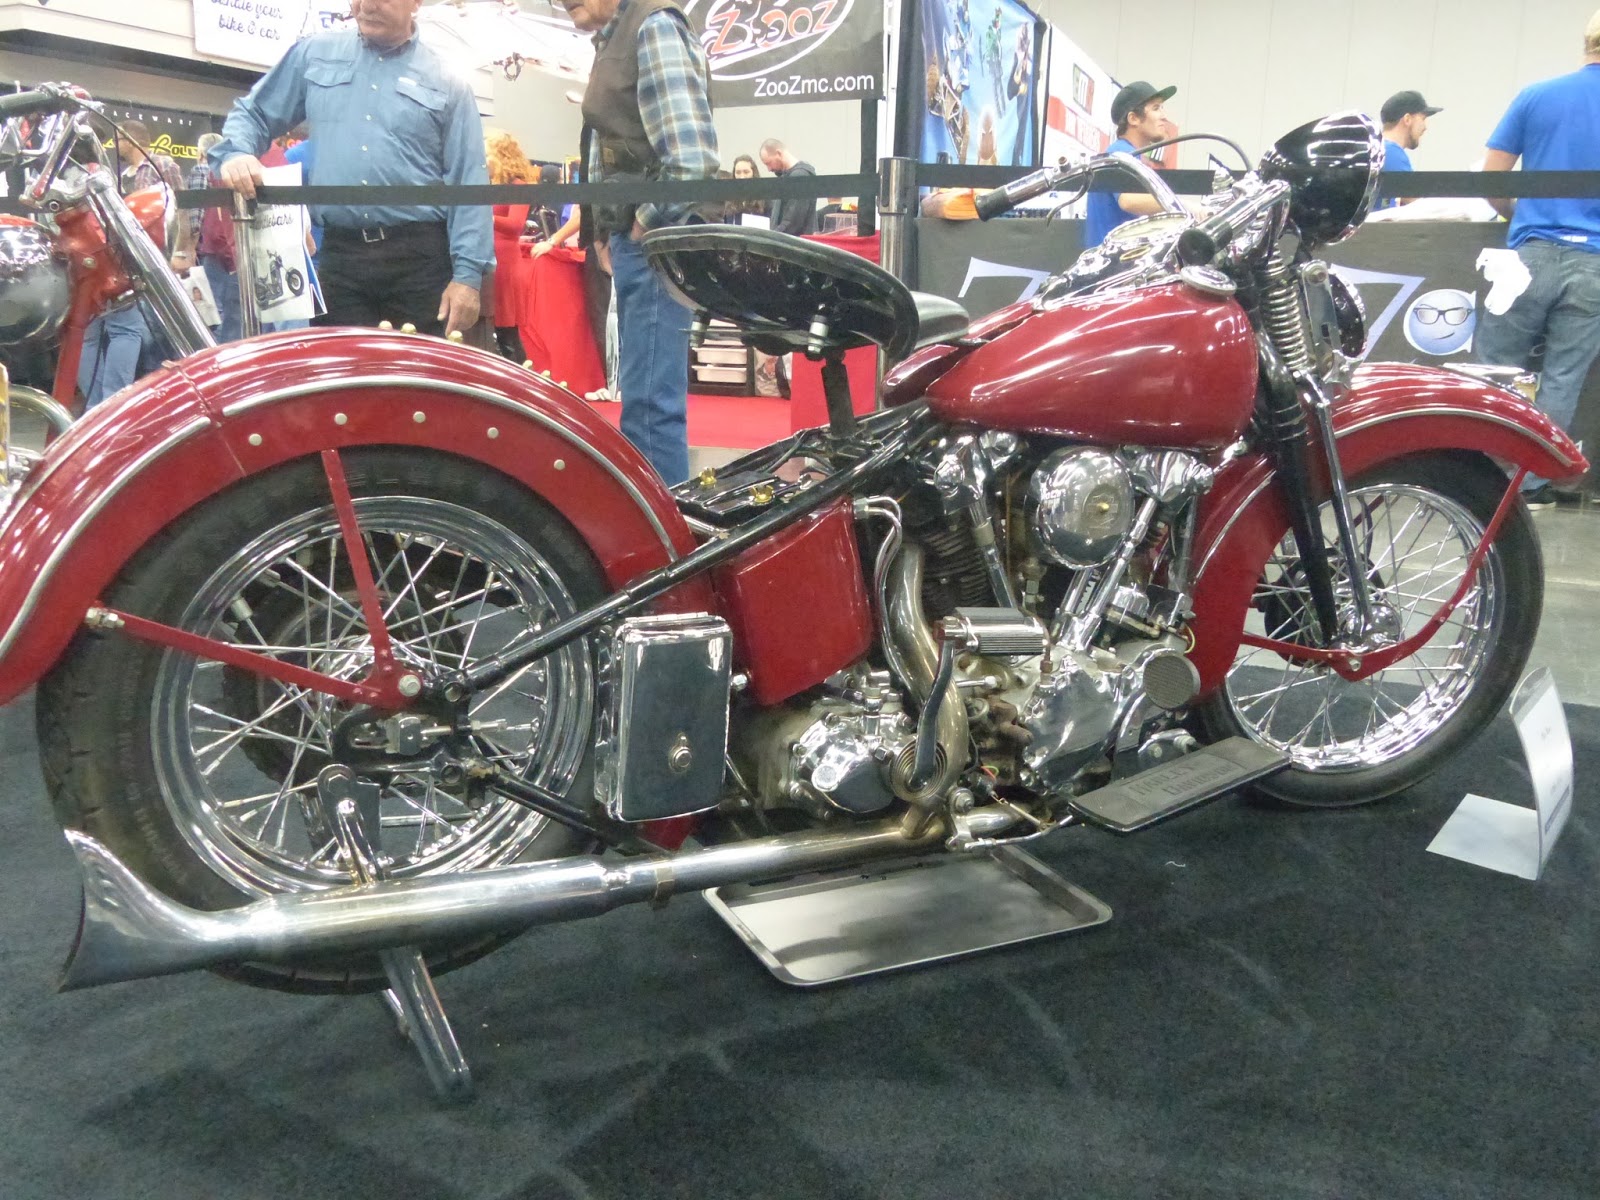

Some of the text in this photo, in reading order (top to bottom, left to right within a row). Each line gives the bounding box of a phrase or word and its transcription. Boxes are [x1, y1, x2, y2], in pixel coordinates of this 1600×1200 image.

[255, 4, 283, 19] your
[218, 14, 280, 41] bike & car
[754, 74, 875, 98] ZooZmc.com
